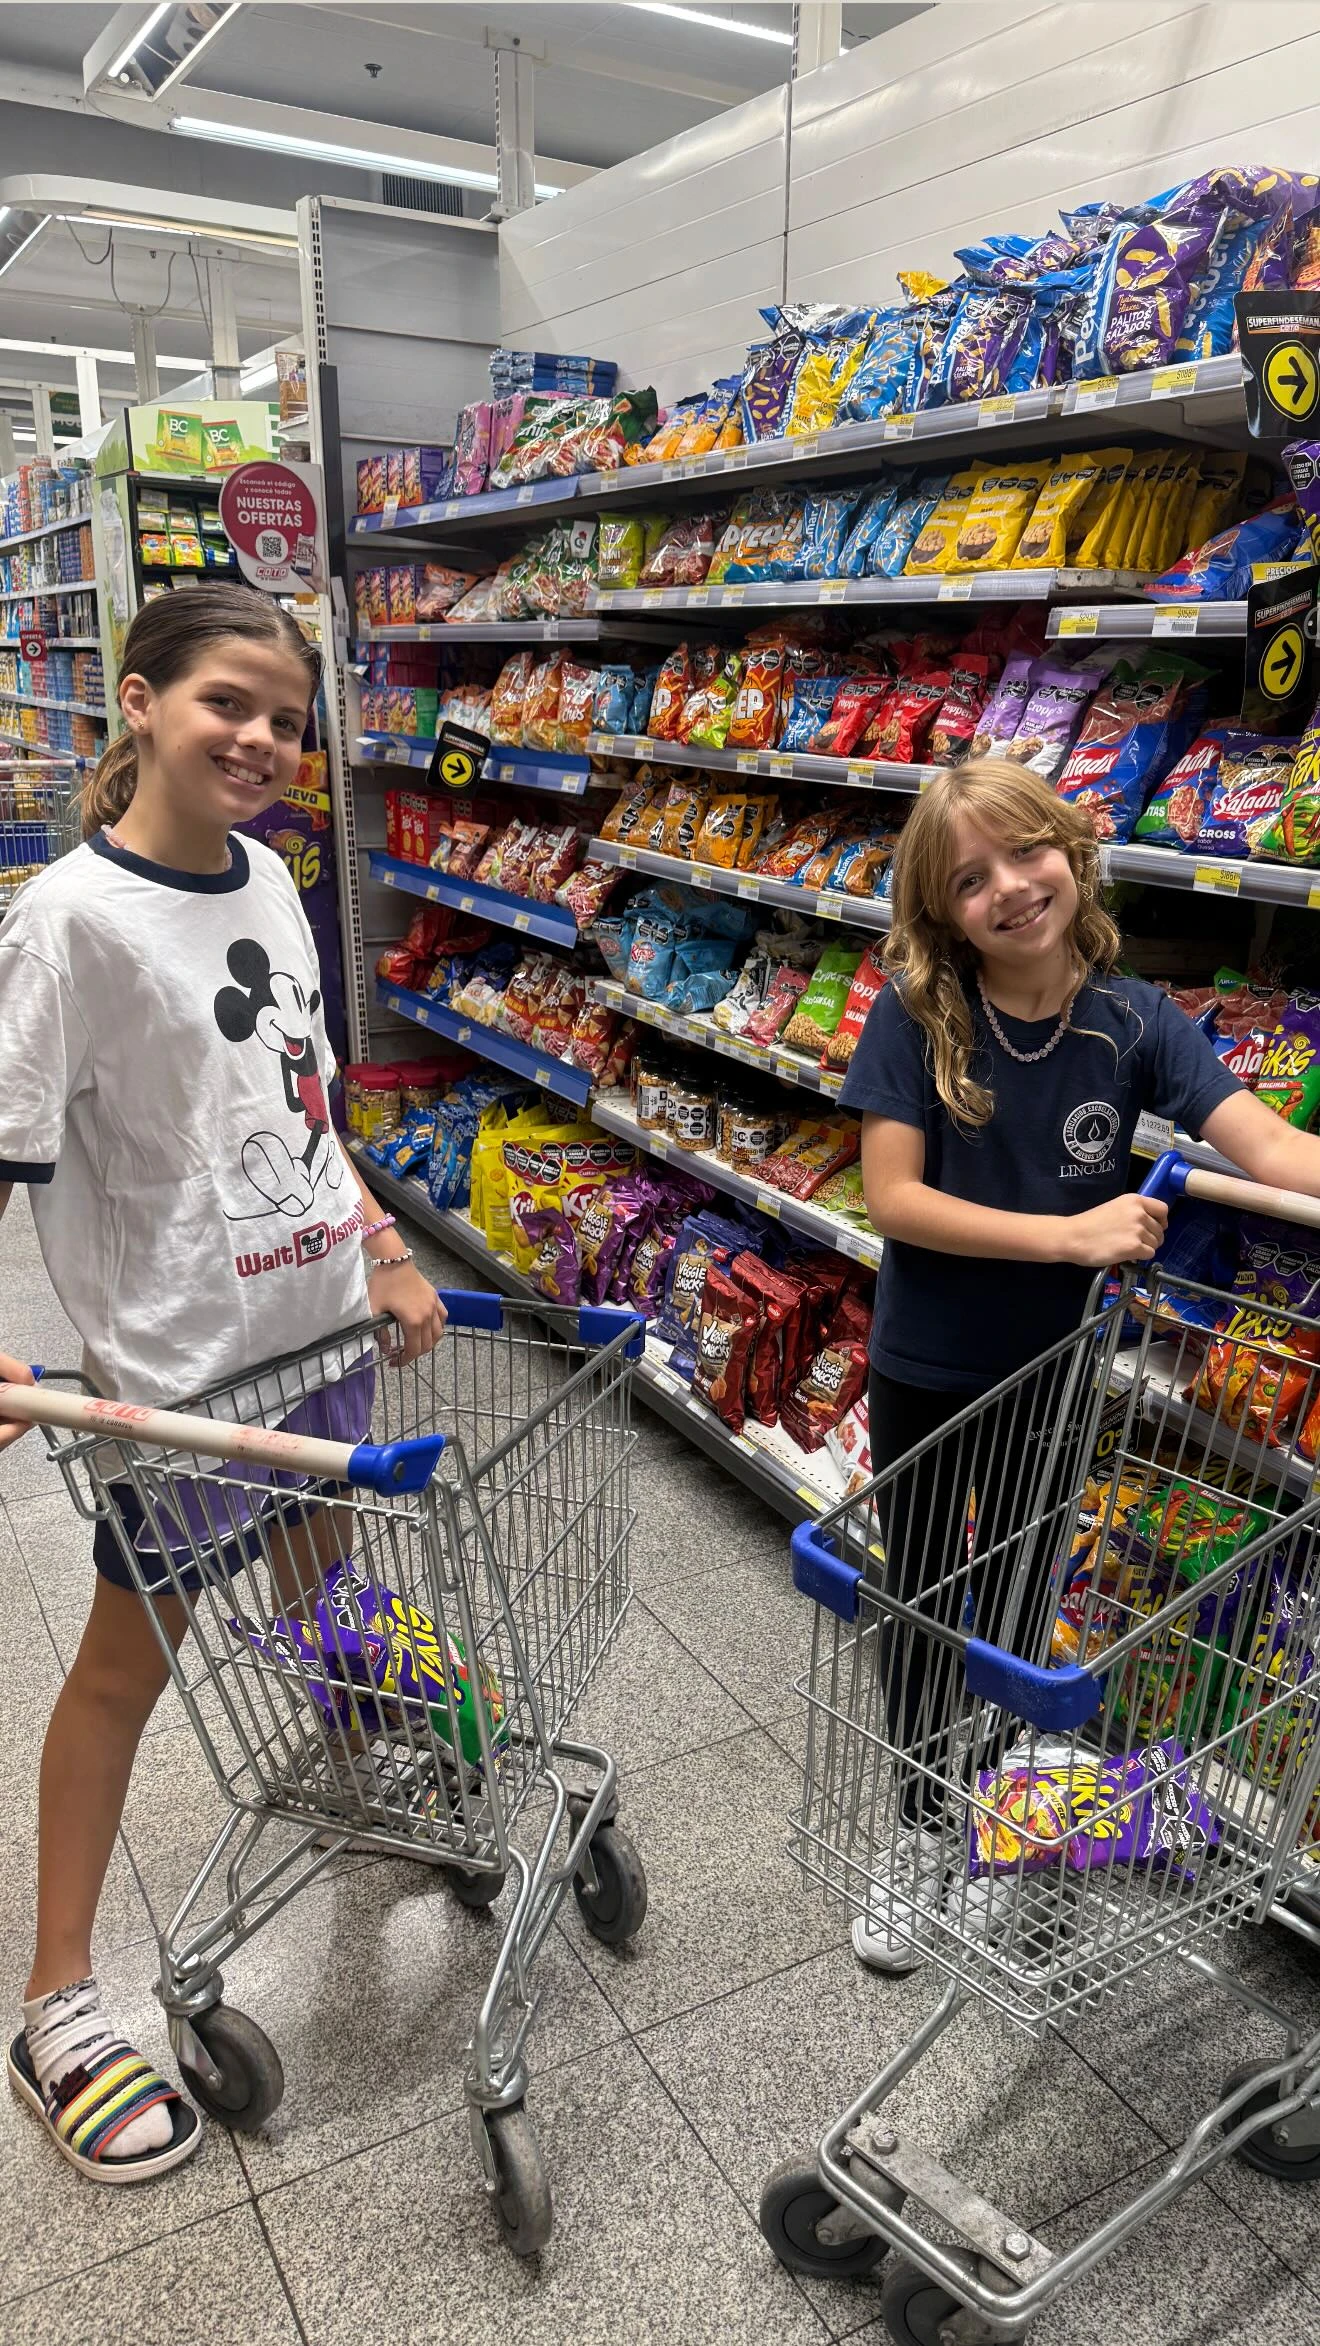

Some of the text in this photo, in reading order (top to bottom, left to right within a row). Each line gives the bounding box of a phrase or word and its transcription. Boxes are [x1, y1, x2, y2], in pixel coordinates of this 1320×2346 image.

[1248, 316, 1320, 328] SUPERFINDESEMAN
[170, 418, 189, 432] BC
[208, 428, 230, 443] BC
[236, 497, 303, 511] NUESTRAS
[237, 511, 304, 527] OFERTAS
[256, 567, 289, 577] COTO
[1063, 750, 1117, 779] aladix
[283, 786, 319, 806] UEVO
[1213, 787, 1284, 816] Saladix
[1198, 829, 1237, 840] CROSS
[1058, 1158, 1116, 1178] LINCOLN
[235, 1212, 366, 1278] Walt Disney
